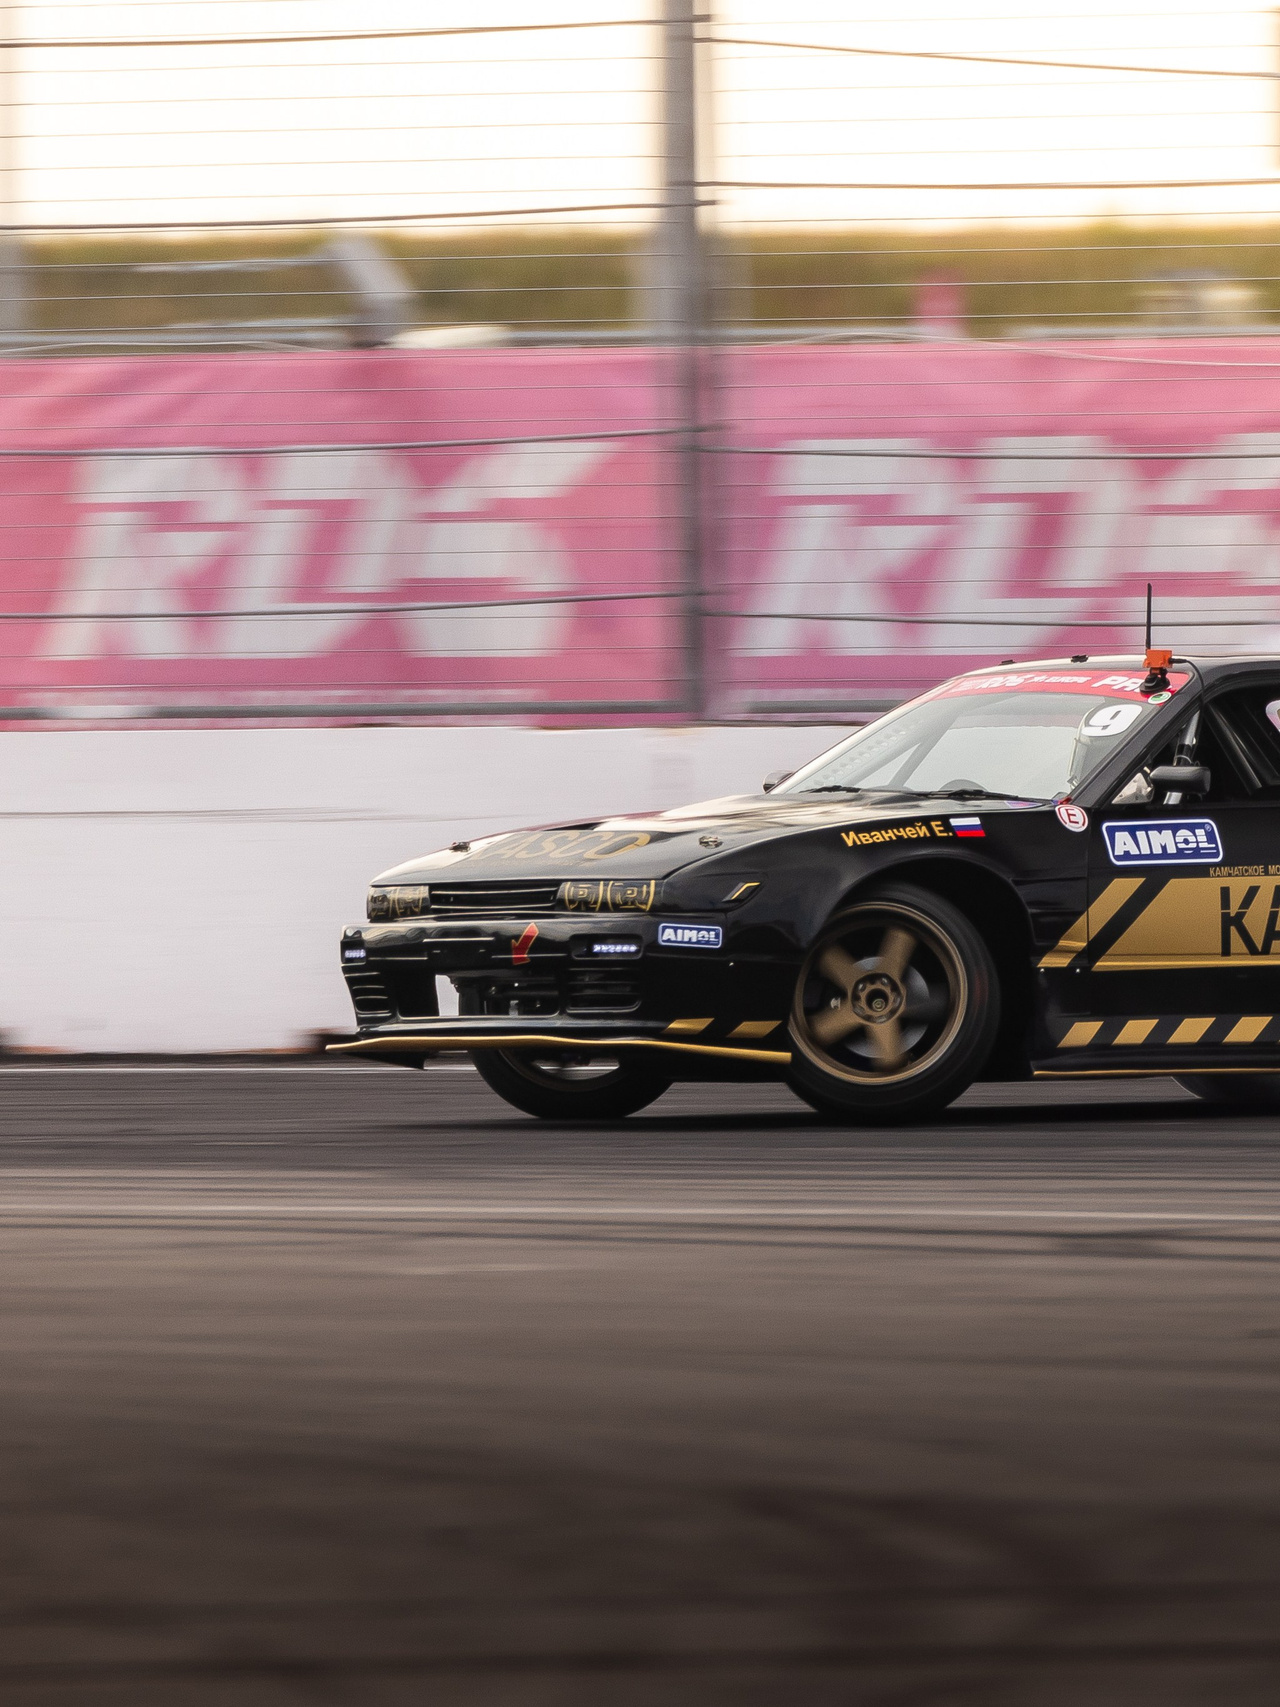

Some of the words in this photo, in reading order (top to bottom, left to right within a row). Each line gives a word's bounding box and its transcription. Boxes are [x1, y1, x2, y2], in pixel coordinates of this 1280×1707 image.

[34, 442, 618, 659] RDS
[1081, 704, 1143, 737] 9
[1065, 808, 1080, 824] E
[841, 823, 931, 847] Иванчей
[931, 821, 954, 837] Е.
[1114, 829, 1217, 855] AIMOL
[1210, 865, 1265, 877] КАМЧАТСКОЕ
[662, 928, 719, 944] AIMOL
